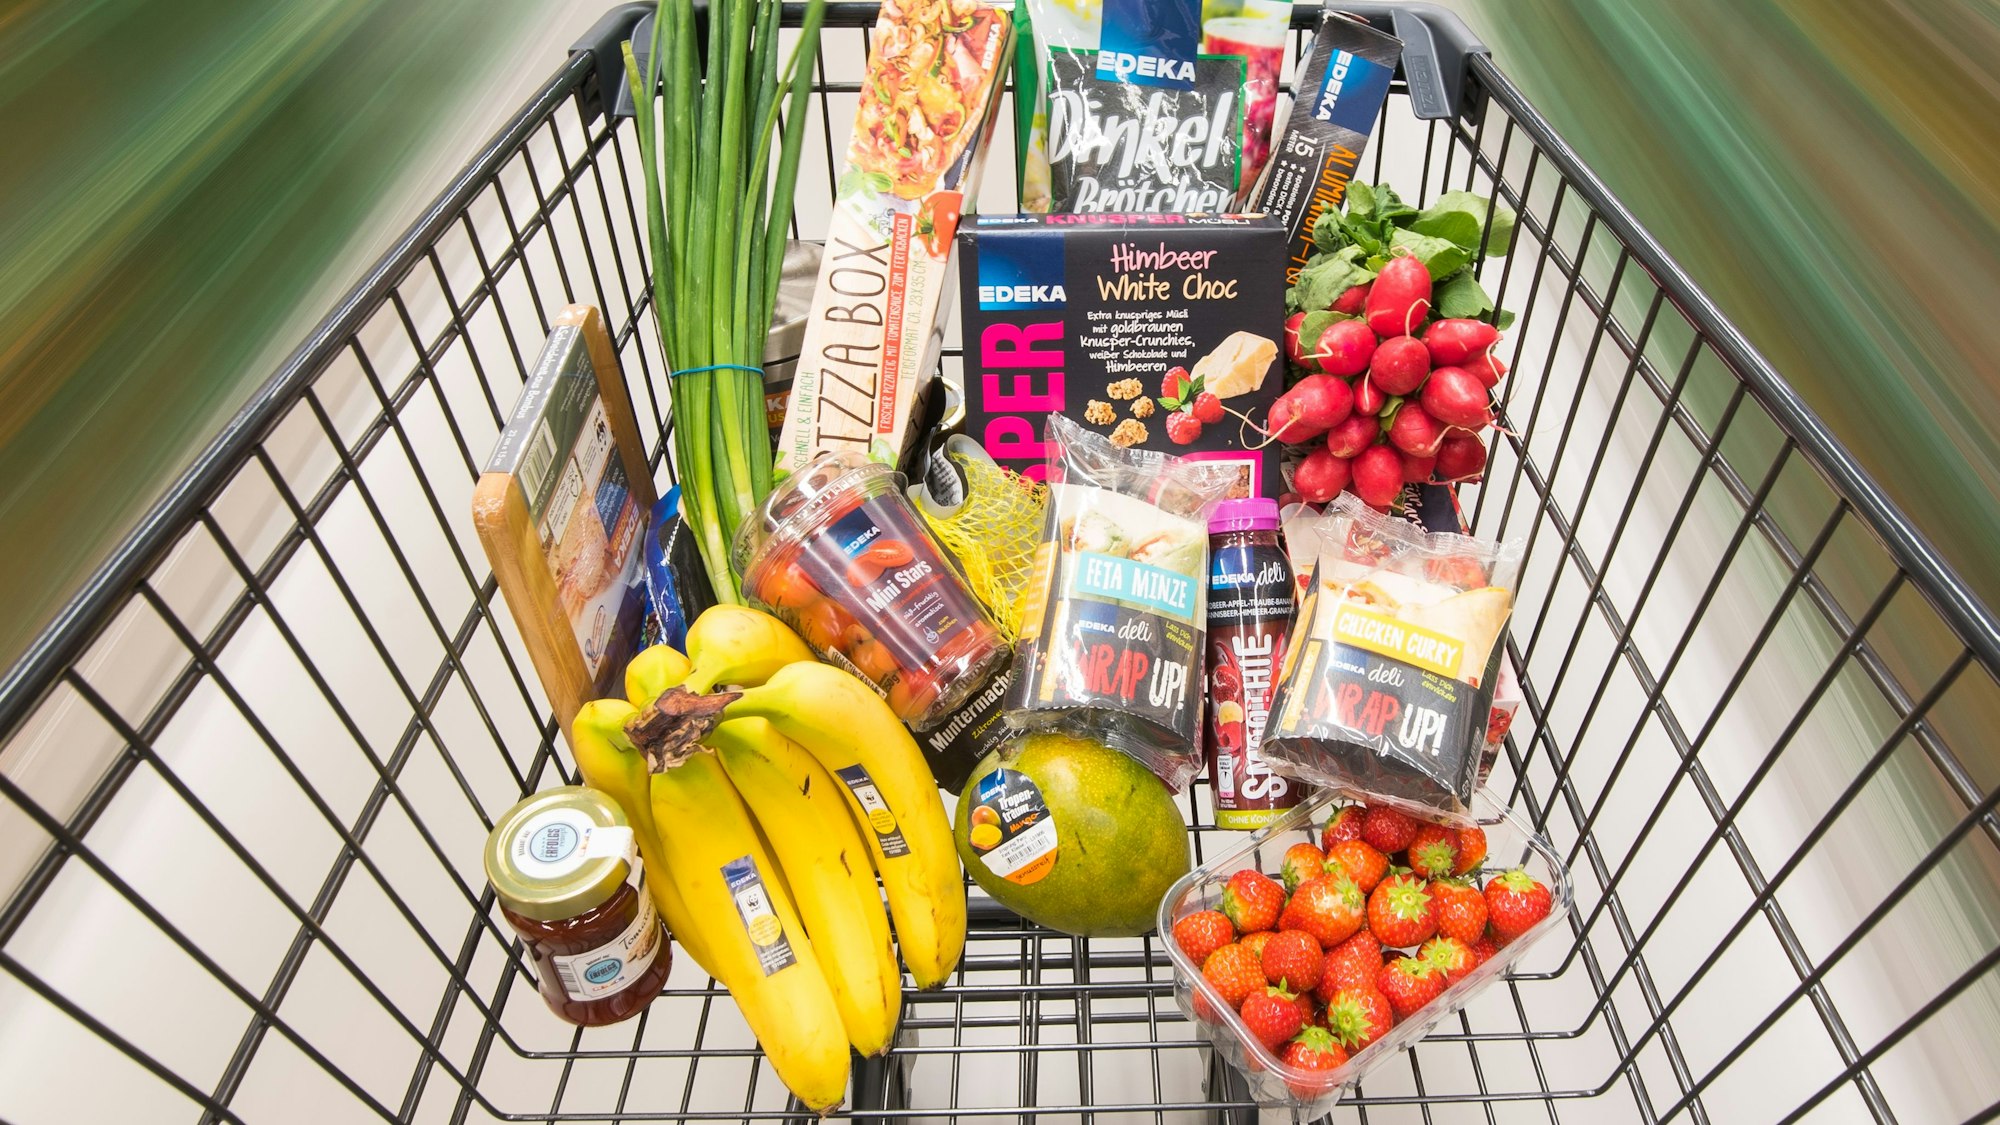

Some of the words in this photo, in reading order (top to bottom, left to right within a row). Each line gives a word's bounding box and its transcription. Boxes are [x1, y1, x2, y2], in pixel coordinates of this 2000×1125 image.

[981, 23, 1001, 70] EDEKA
[1096, 50, 1196, 83] EDEKA
[1315, 50, 1353, 121] EDEKA
[1049, 89, 1235, 184] Dinkel
[1285, 129, 1300, 154] METER
[1294, 133, 1319, 158] 15
[1277, 189, 1288, 209] DICK
[1046, 214, 1186, 225] KNUSPER
[1188, 217, 1251, 225] MÜSLI
[894, 218, 909, 268] FERTIGBACKEN
[1111, 242, 1218, 274] Himbeer
[825, 237, 889, 326] BOX
[892, 272, 906, 287] ZUM
[1097, 273, 1170, 302] White
[1183, 273, 1239, 301] Choc
[978, 285, 1067, 303] EDEKA
[888, 289, 904, 342] TOMATENSAUCE
[1087, 310, 1112, 320] Extra
[1115, 310, 1162, 322] knuspriges
[1166, 309, 1189, 318] Müsli
[1092, 324, 1108, 333] mit
[1110, 320, 1183, 338] goldbraunen
[886, 344, 899, 356] MIT
[901, 326, 919, 381] TEIGFORMAT
[1080, 333, 1196, 351] Knusper-Crunchies,
[1089, 350, 1120, 360] weißer
[1123, 350, 1168, 359] Schokolade
[1171, 349, 1188, 358] und
[883, 358, 897, 394] PIZZATEIG
[1106, 360, 1167, 373] Himbeeren
[516, 389, 541, 419] Bambus
[797, 371, 814, 412] EINFACH
[813, 343, 880, 462] IZZA
[800, 414, 813, 425] &
[879, 395, 894, 430] FRISCHER
[794, 426, 812, 469] SCHNELL
[615, 504, 640, 569] EDEKA
[844, 525, 881, 556] EDEKA
[865, 578, 903, 613] Mini
[900, 559, 933, 592] Stars
[1086, 557, 1123, 590] FETA
[1131, 567, 1188, 609] MINZE
[1211, 571, 1256, 586] EDEKA
[1257, 563, 1286, 586] deli
[914, 602, 945, 628] aromatisch
[1077, 620, 1115, 634] EDEKA
[1118, 618, 1153, 642] deli
[1338, 611, 1404, 650] CHICKEN
[1405, 634, 1458, 668] CURRY
[1148, 657, 1188, 711] UP!
[1368, 663, 1405, 688] deli
[1422, 671, 1439, 683] Lass
[1439, 678, 1454, 691] Dich
[1233, 633, 1289, 800] SMOOTHIE
[1398, 703, 1448, 757] UP!
[974, 735, 999, 760] fruchtig
[981, 783, 1008, 802] EDEKA
[998, 789, 1035, 811] Tropen-
[1002, 803, 1030, 824] traum
[1010, 811, 1039, 834] Mango
[1228, 816, 1249, 825] OHNE
[545, 828, 560, 858] ERFOLGS
[730, 872, 757, 889] EDEKA
